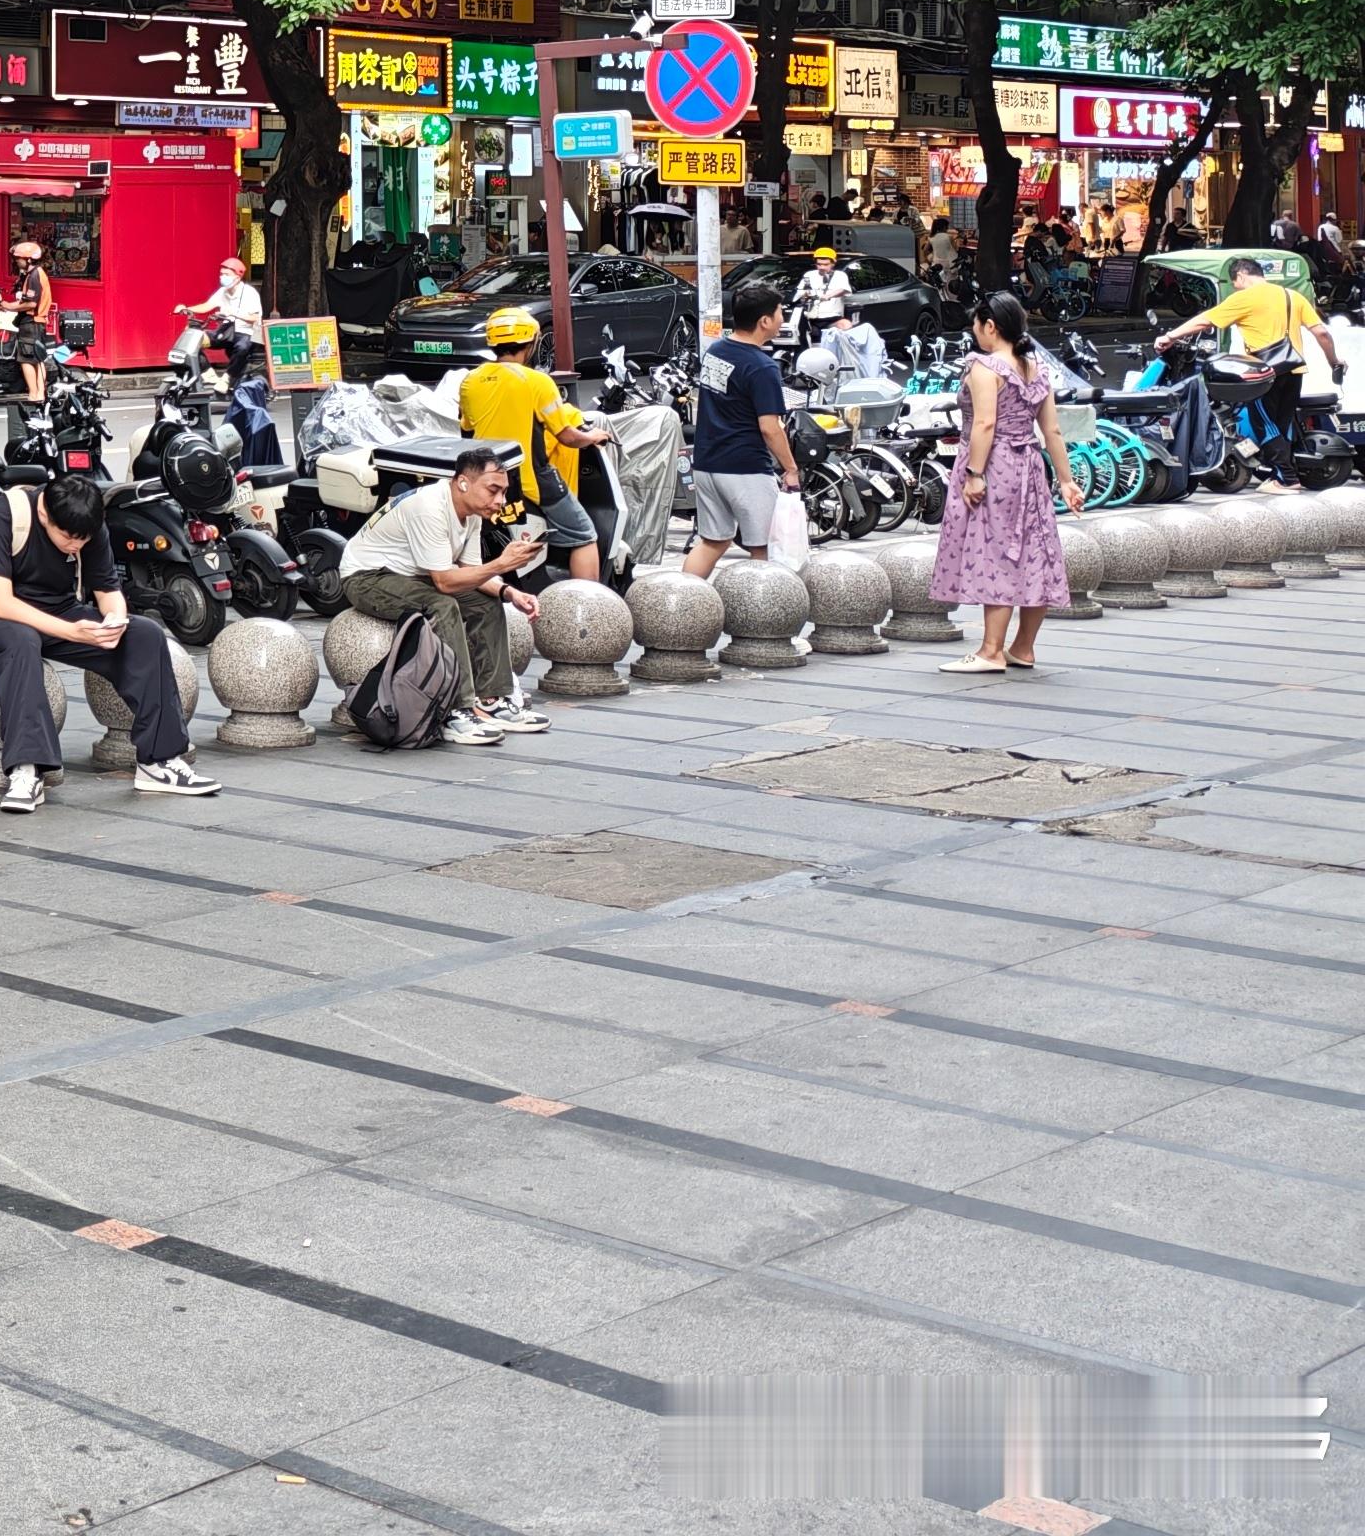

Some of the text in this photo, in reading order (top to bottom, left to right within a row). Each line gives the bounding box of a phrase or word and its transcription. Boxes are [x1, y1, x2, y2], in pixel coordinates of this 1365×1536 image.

[417, 55, 439, 66] ZHOU
[336, 48, 404, 92] 周容記
[185, 77, 201, 85] RICH
[456, 56, 539, 97] 头号粽子
[844, 67, 882, 99] 亚信
[174, 85, 211, 95] RESTAURANT
[38, 144, 91, 155] 中国福利彩票
[162, 145, 206, 155] 中国福利彩票
[667, 151, 737, 175] 严管路段
